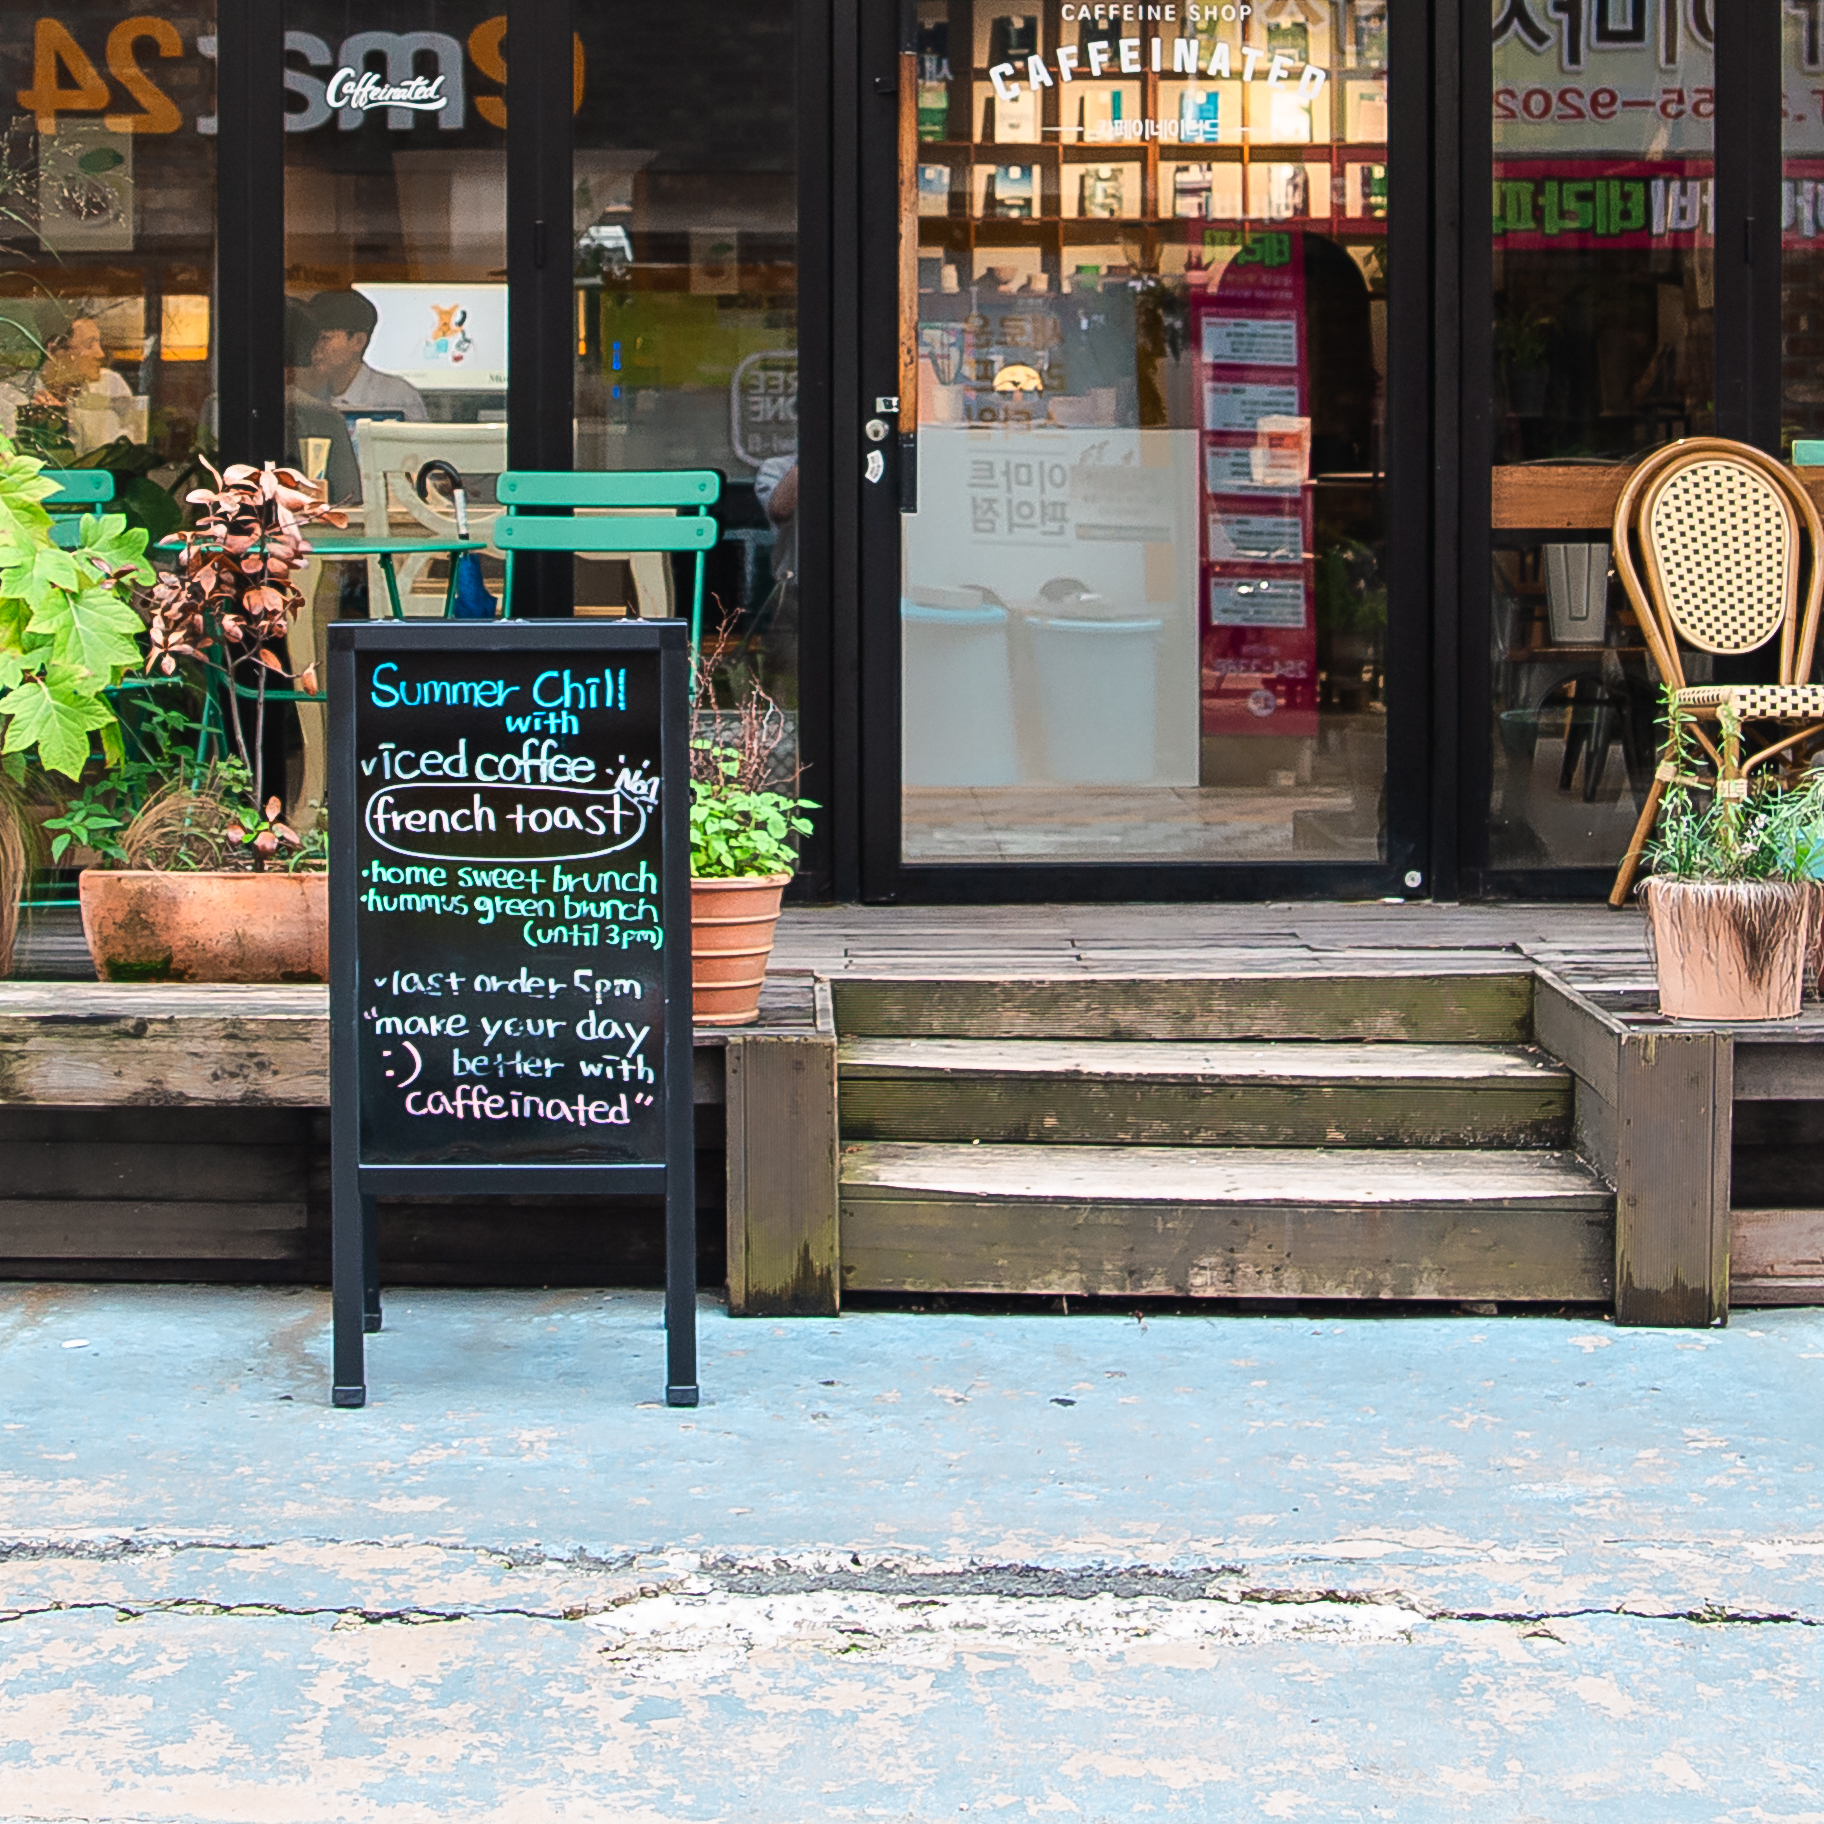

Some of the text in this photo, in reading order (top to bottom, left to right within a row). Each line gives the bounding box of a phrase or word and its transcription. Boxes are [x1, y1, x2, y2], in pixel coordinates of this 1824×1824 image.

[1060, 3, 1253, 22] CAFFEINE SHOP
[987, 36, 1327, 102] CAFFEINATED
[326, 66, 448, 111] Caffeinated
[371, 662, 520, 709] Summer
[505, 711, 579, 735] with
[379, 738, 597, 784] iced coffee
[372, 793, 634, 837] french toast
[457, 865, 547, 892] sweet
[553, 861, 657, 895] brunch
[474, 895, 555, 924] green
[564, 895, 658, 923] brunch
[523, 923, 664, 950] (until 3pm)
[392, 968, 642, 1003] last order 5pm
[481, 1016, 566, 1046] your
[576, 1010, 650, 1058] day
[452, 1049, 564, 1078] better
[579, 1053, 655, 1084] with
